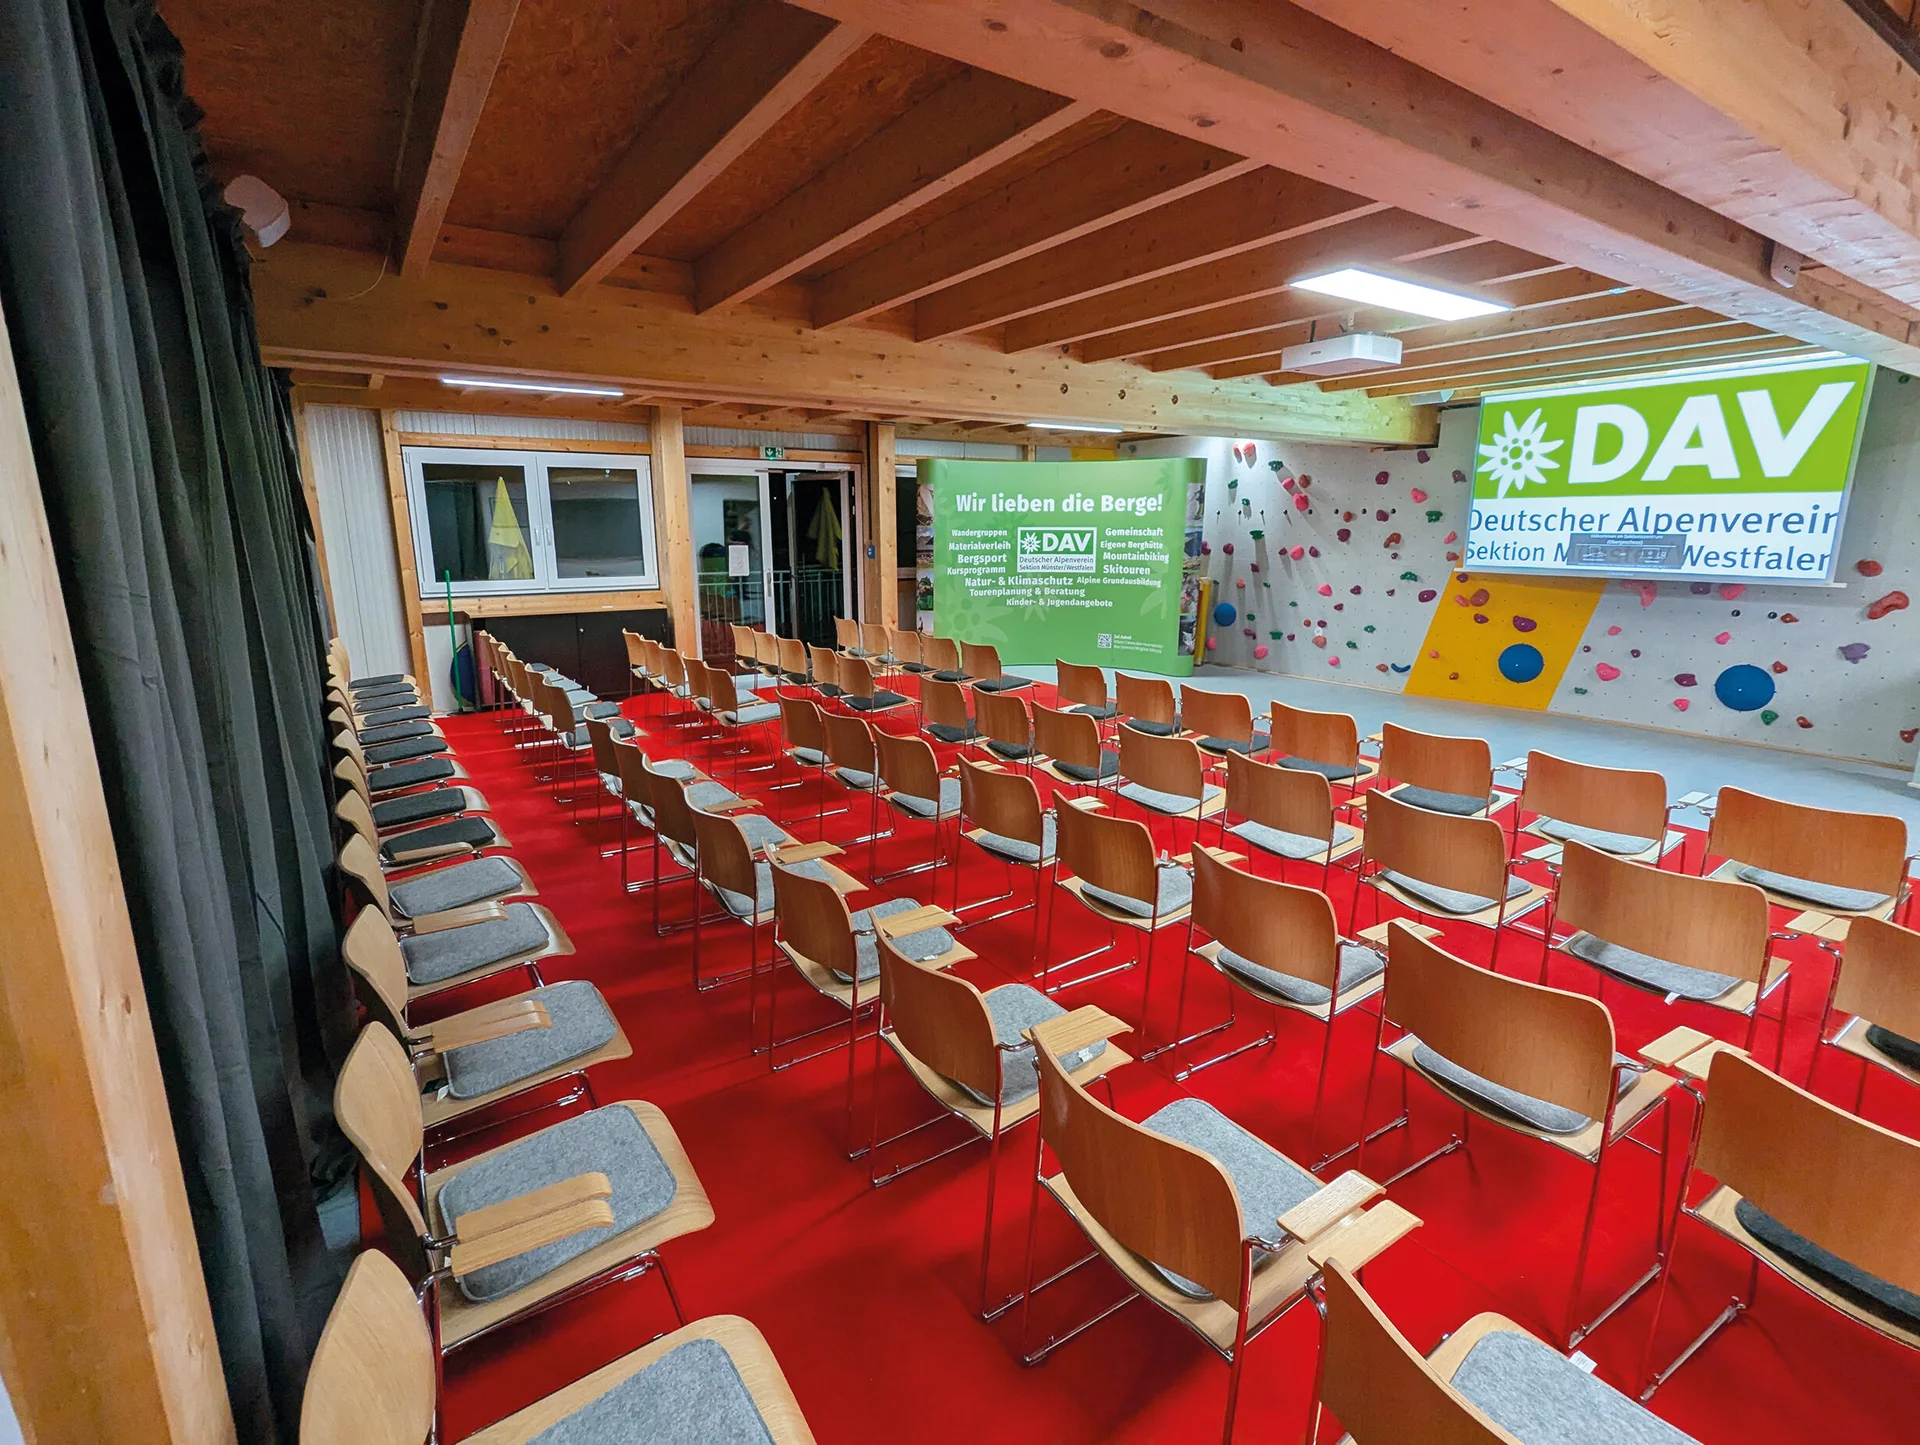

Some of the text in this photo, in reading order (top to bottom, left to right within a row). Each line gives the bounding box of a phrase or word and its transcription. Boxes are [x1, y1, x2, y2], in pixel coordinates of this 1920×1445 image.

[1568, 382, 1855, 483] DAV
[956, 493, 1163, 516] Wir lieben die Berge!
[1469, 507, 1610, 531] Deutscher
[952, 529, 1007, 537] Wandergruppen
[1105, 527, 1163, 537] Gemeinschaft
[949, 541, 1011, 551] Materialverleih
[1042, 533, 1091, 551] DAV
[1100, 541, 1163, 550] Eigene Berghütte
[1466, 540, 1545, 561] Sektion
[957, 553, 1007, 564] Bergsport
[1019, 556, 1094, 564] Deutscher Alpenverein
[1103, 552, 1169, 563] Mountainbiking
[947, 566, 1006, 576] Kursprogramm
[1103, 564, 1150, 575] Skitouren
[965, 576, 1073, 587] Natur- & Klimaschutz
[1077, 576, 1161, 588] Alpine Grundausbildung
[969, 588, 1032, 597] Tourenplanung
[1044, 588, 1085, 597] Beratung
[1006, 598, 1036, 606] Kinder-
[1047, 598, 1113, 607] Jugendangebote
